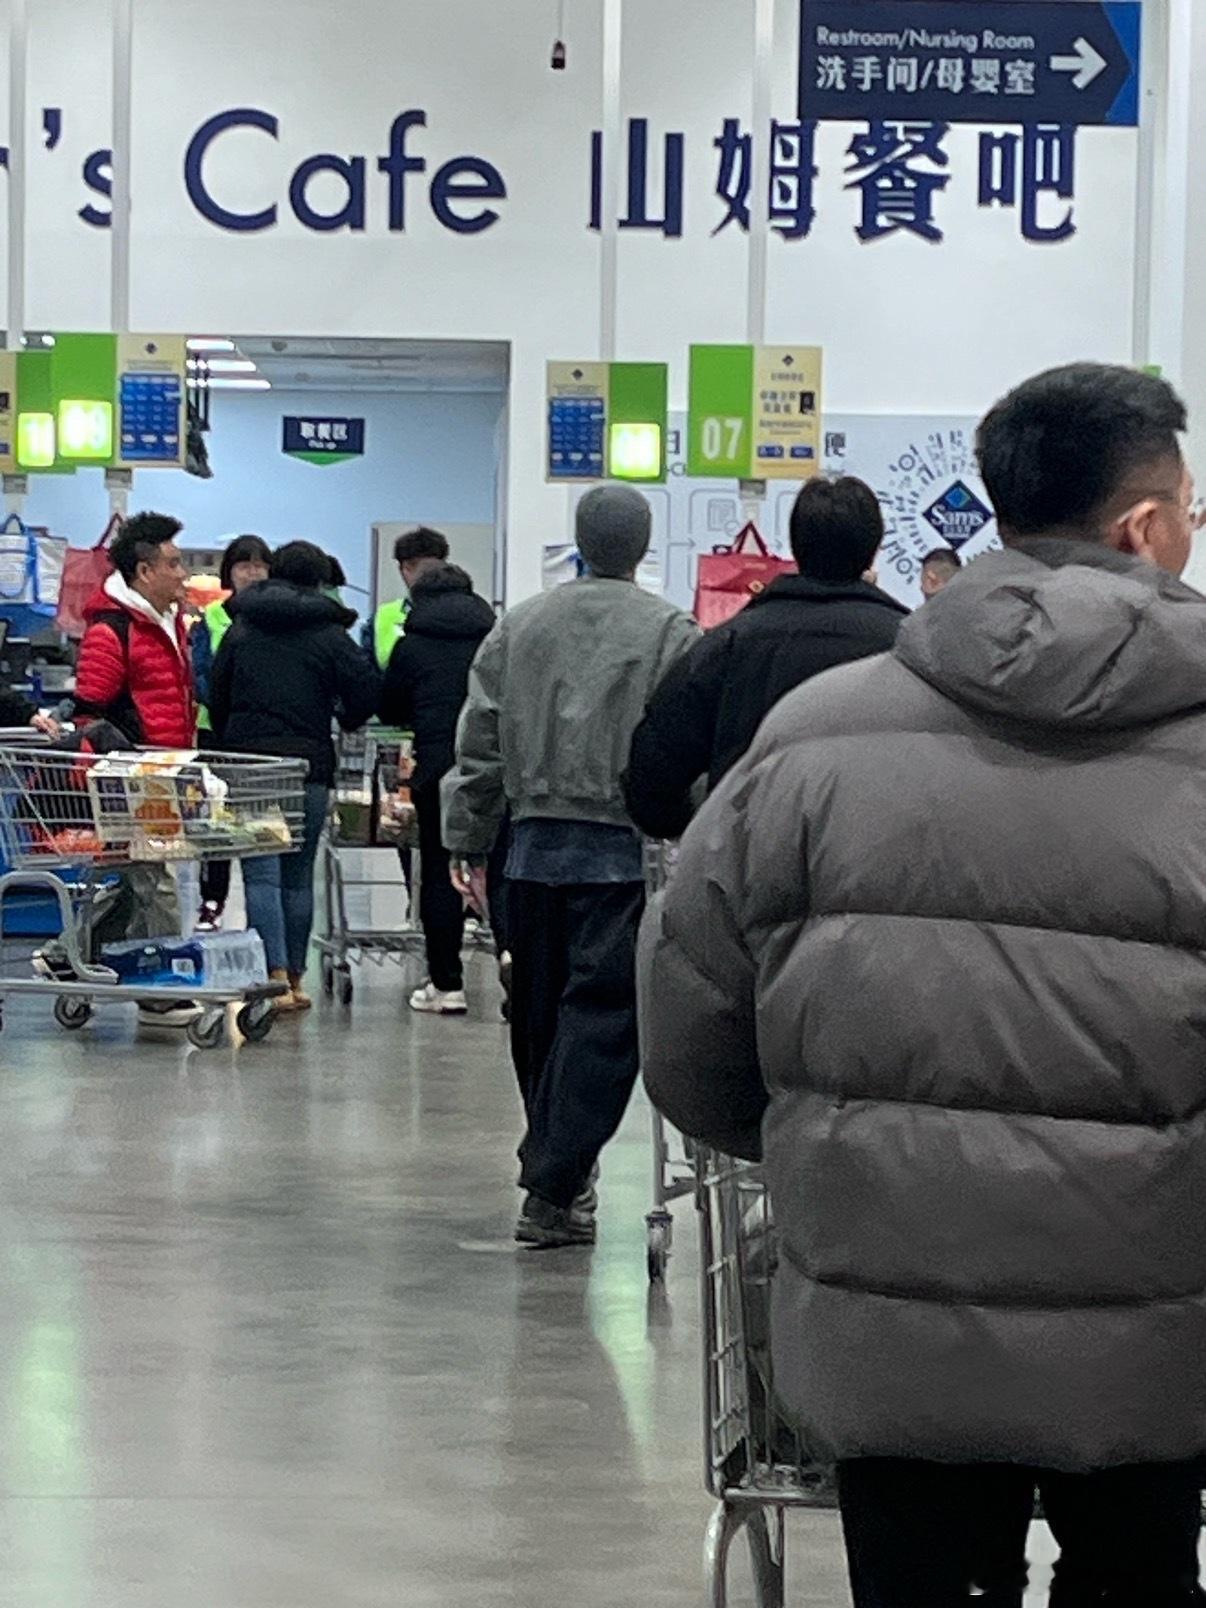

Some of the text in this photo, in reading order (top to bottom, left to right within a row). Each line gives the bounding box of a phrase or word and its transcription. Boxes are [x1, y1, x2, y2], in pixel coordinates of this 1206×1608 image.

[816, 25, 1035, 53] Restroom/Nursing Room
[816, 55, 1036, 95] 洗手间/母婴室
[184, 108, 507, 234] Cafe
[588, 118, 1077, 243] 山姆餐吧
[702, 416, 743, 460] 07
